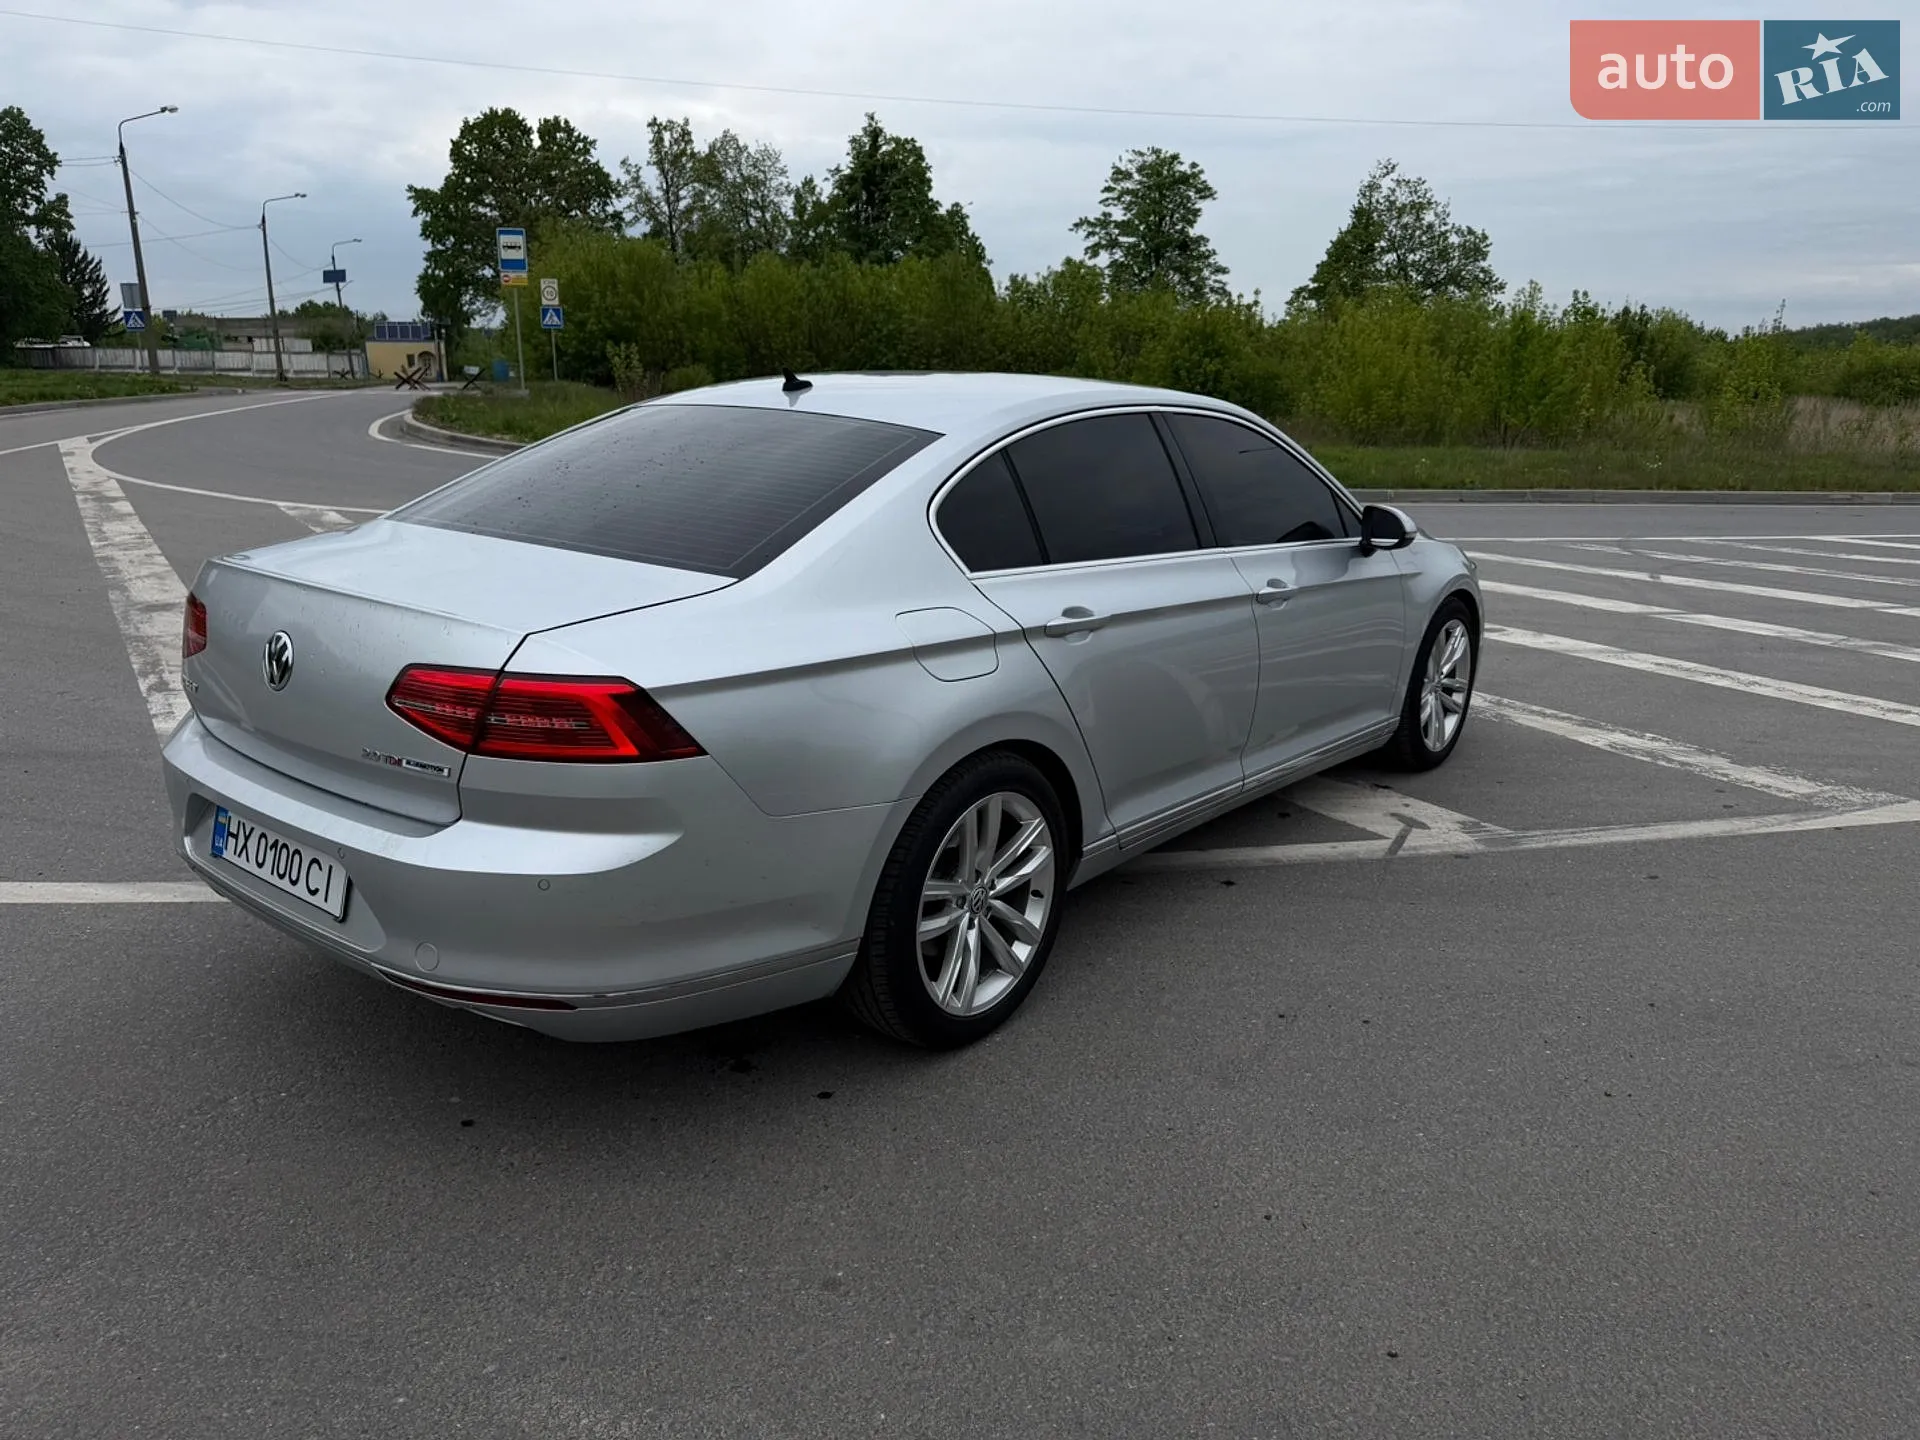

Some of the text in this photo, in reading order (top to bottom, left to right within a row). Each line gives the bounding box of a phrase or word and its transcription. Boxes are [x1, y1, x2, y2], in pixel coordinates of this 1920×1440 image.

[225, 815, 333, 903] HX 0100 CI
